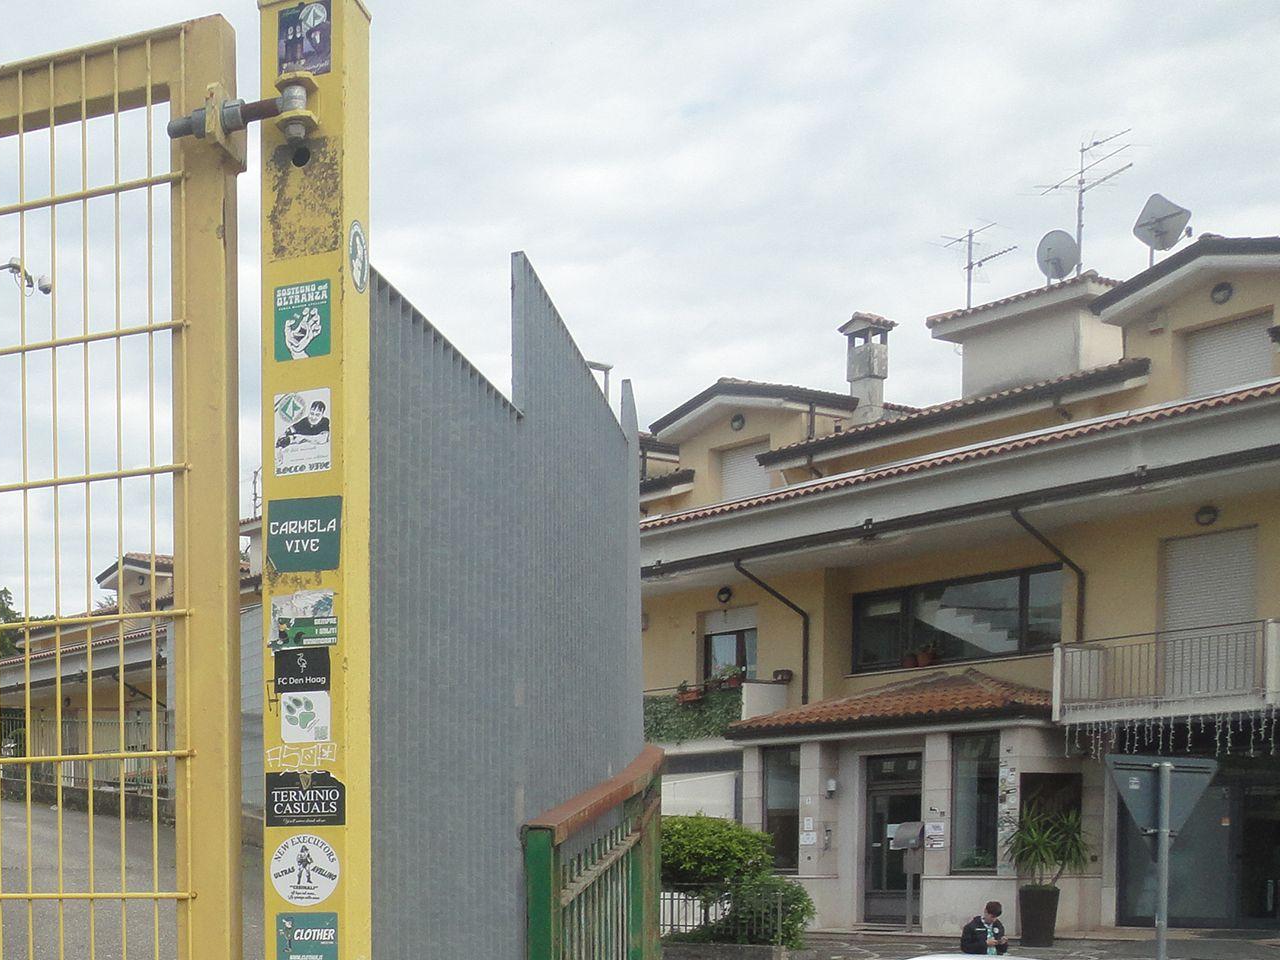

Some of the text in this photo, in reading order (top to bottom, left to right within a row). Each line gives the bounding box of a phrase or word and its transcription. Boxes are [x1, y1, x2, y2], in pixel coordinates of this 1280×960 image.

[276, 290, 328, 307] OLTRANZA
[269, 518, 337, 535] CARMELA
[285, 538, 320, 553] VIVE
[277, 676, 326, 686] FC Den Haag
[271, 788, 340, 802] TERMINIO
[273, 801, 338, 815] CASUALS
[274, 835, 337, 864] NEW EXECUTORS
[273, 865, 338, 882] ULTRAS AVELLINO
[293, 928, 336, 941] CLOTHER
